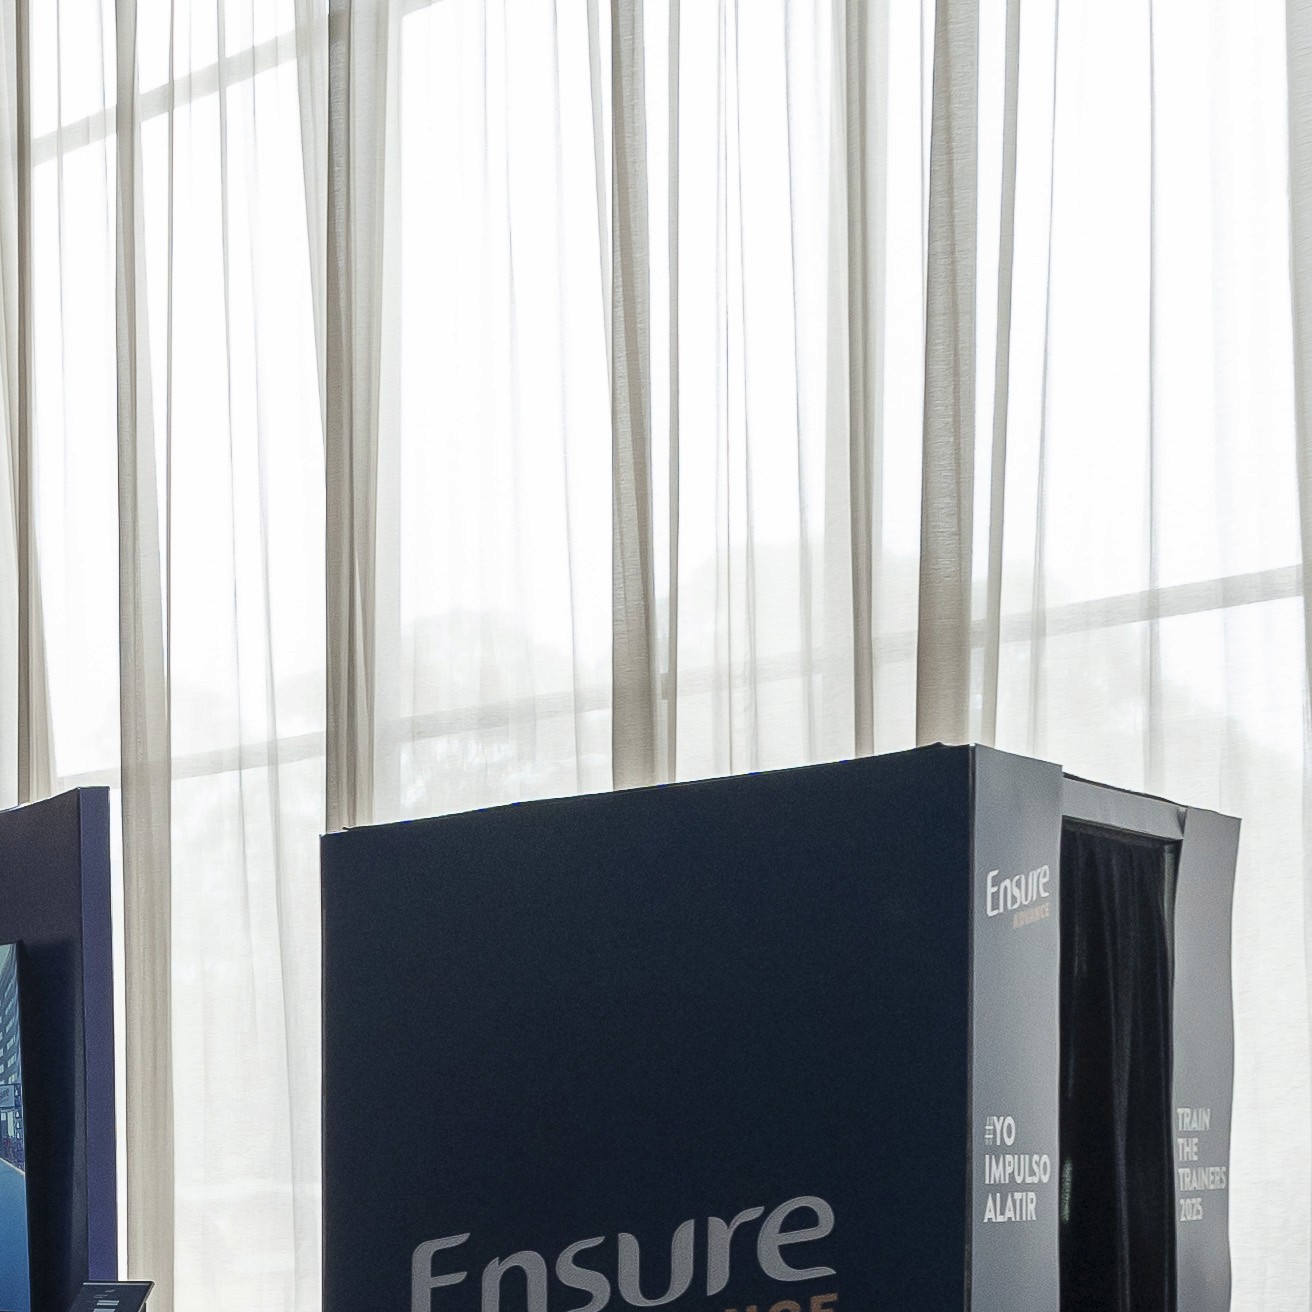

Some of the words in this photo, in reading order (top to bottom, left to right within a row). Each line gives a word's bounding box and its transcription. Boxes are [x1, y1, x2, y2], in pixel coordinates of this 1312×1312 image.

[986, 865, 1050, 917] Ensure
[984, 1116, 1016, 1146] #YO
[1177, 1107, 1211, 1131] TRAIN
[1177, 1137, 1199, 1161] THE
[984, 1154, 1051, 1185] IMPULSO
[983, 1191, 1037, 1223] ALATIR
